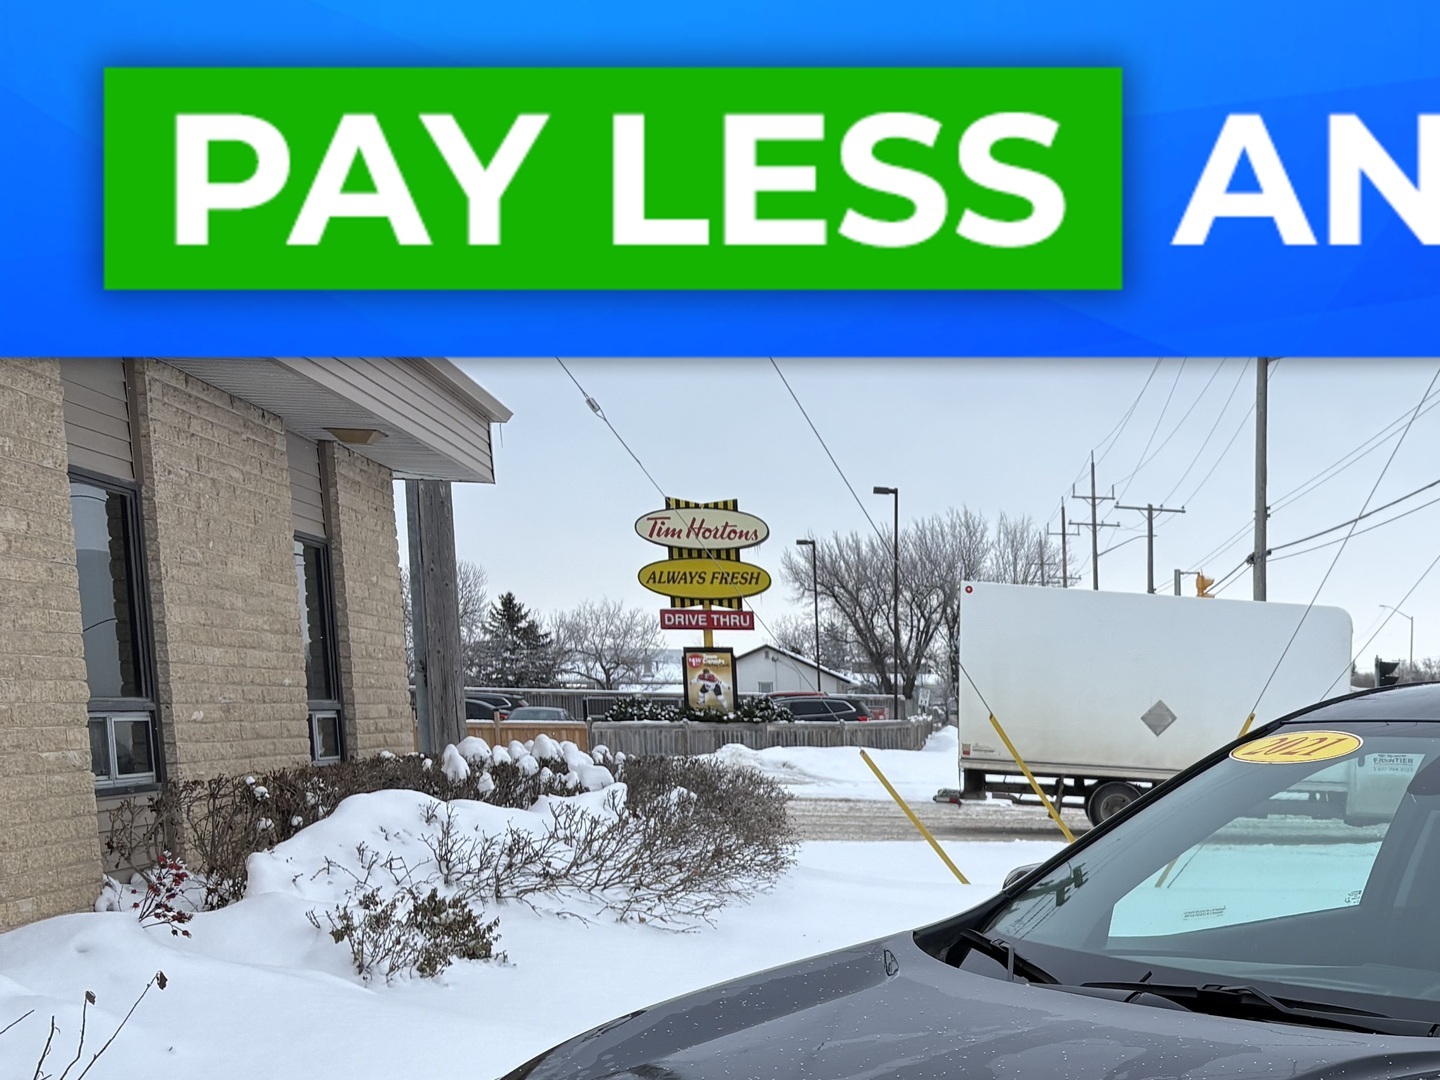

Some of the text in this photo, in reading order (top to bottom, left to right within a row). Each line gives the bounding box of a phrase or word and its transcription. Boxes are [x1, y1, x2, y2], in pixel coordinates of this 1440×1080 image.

[646, 516, 759, 541] Tim Hortons
[645, 570, 762, 586] ALWAYS FRESH
[664, 613, 751, 627] DRIVE THRU
[1242, 736, 1349, 757] 2021
